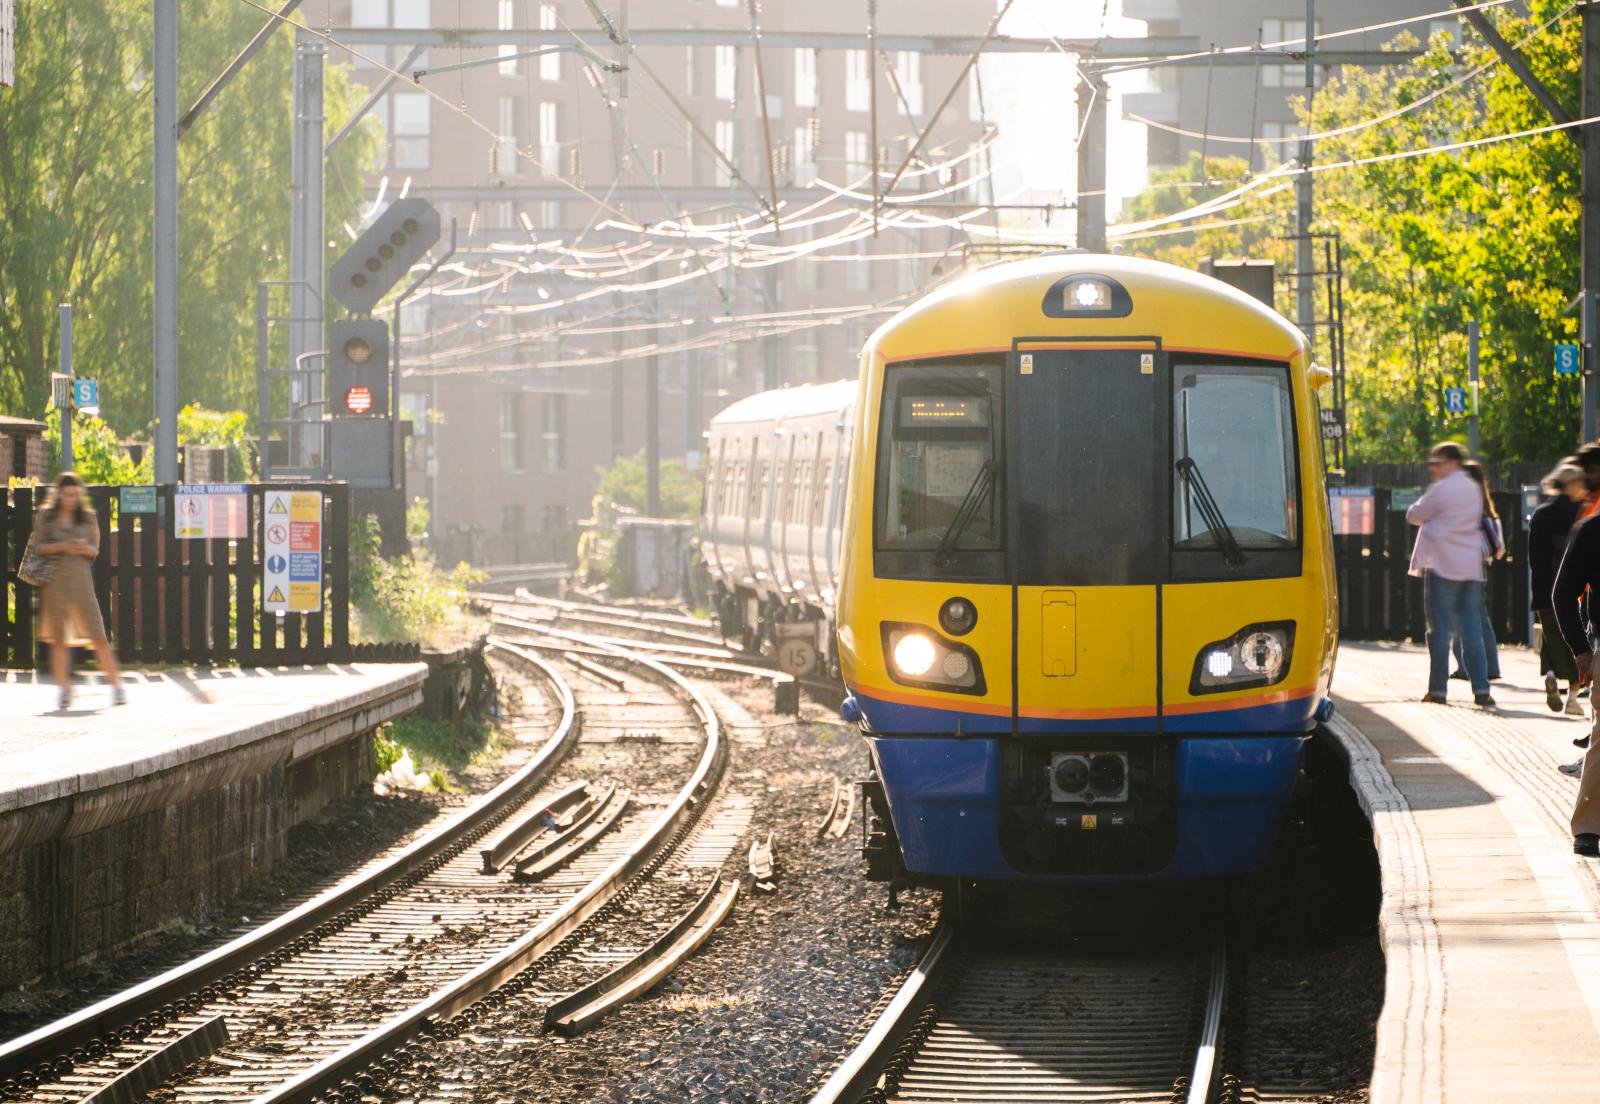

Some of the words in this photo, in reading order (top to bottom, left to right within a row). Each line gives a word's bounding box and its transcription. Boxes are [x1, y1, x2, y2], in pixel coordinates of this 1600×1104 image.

[1562, 349, 1572, 368] S
[80, 384, 91, 401] S
[1450, 391, 1462, 409] R
[178, 485, 206, 493] POLICE
[207, 484, 243, 493] WARNING
[789, 649, 806, 668] 15
